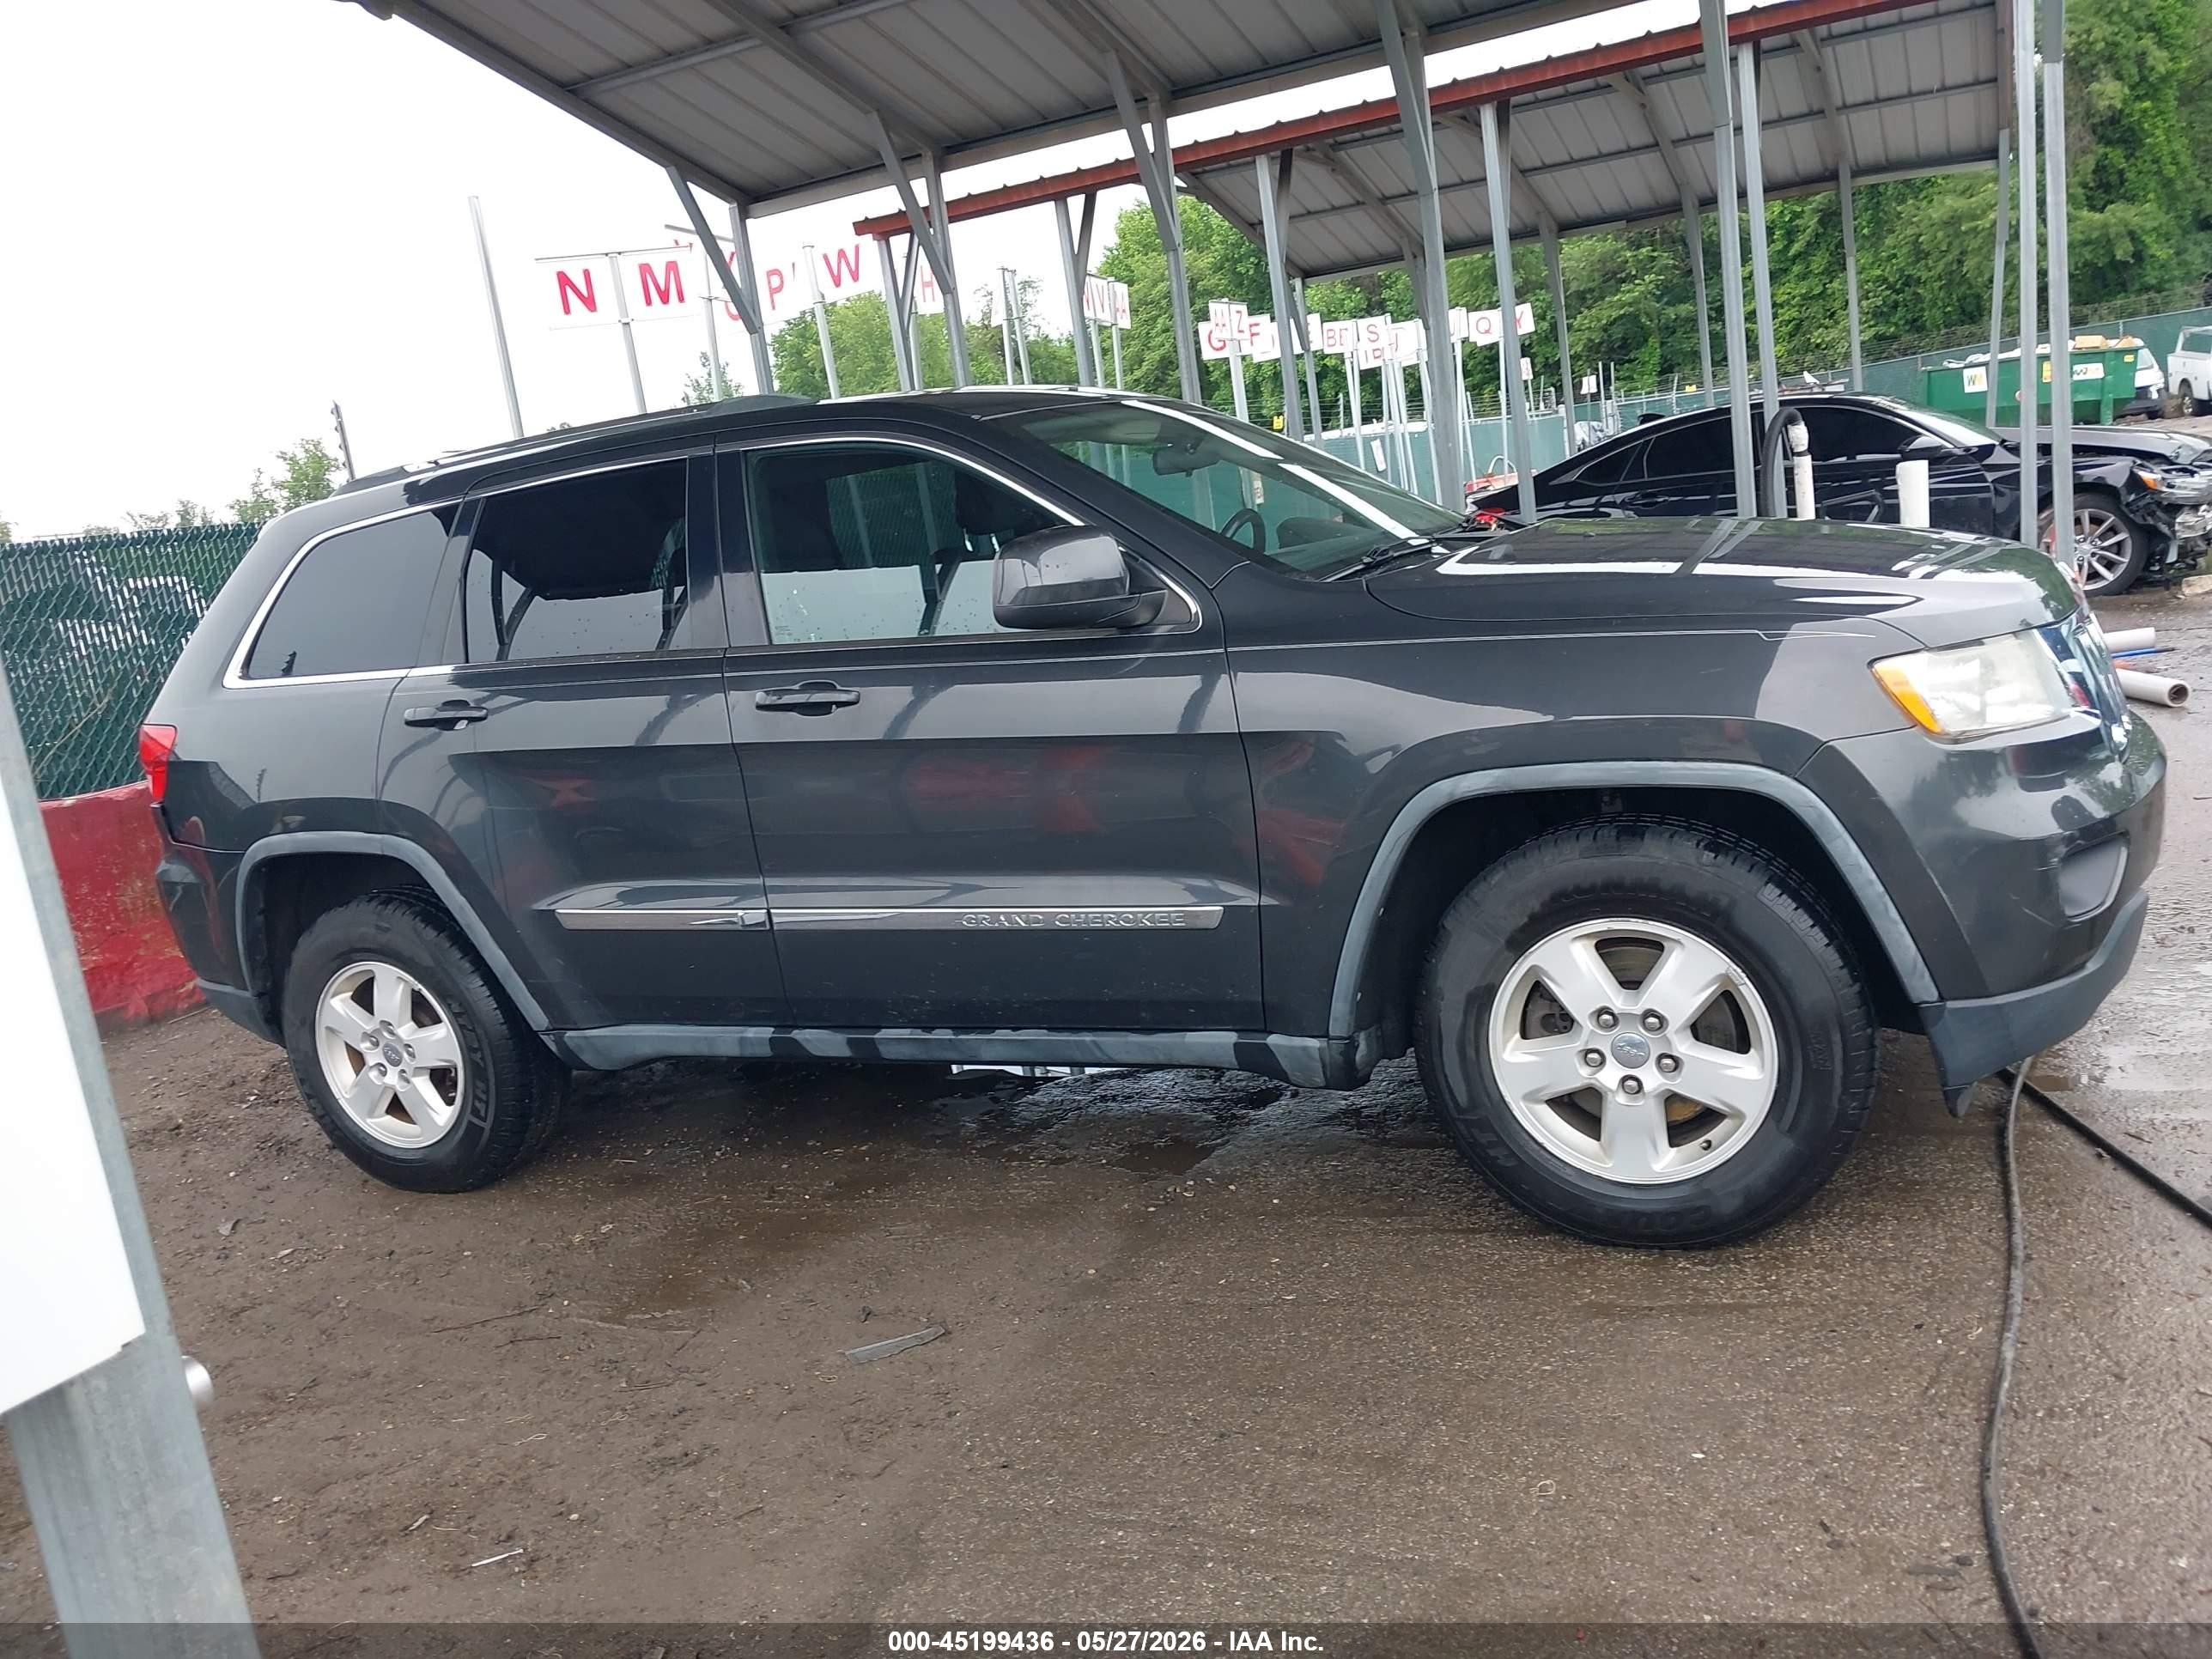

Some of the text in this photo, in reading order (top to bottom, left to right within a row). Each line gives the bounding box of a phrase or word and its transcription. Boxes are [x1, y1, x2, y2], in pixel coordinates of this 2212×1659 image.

[823, 244, 860, 288] W
[556, 268, 598, 315] N
[638, 260, 685, 307] M
[765, 268, 784, 311] P
[920, 264, 935, 302] H
[1235, 309, 1246, 333] Z
[1366, 324, 1380, 343] S
[1475, 316, 1492, 335] Q
[1207, 329, 1227, 351] G
[1249, 322, 1261, 347] F
[961, 913, 1186, 927] GRAND CHEROKEE
